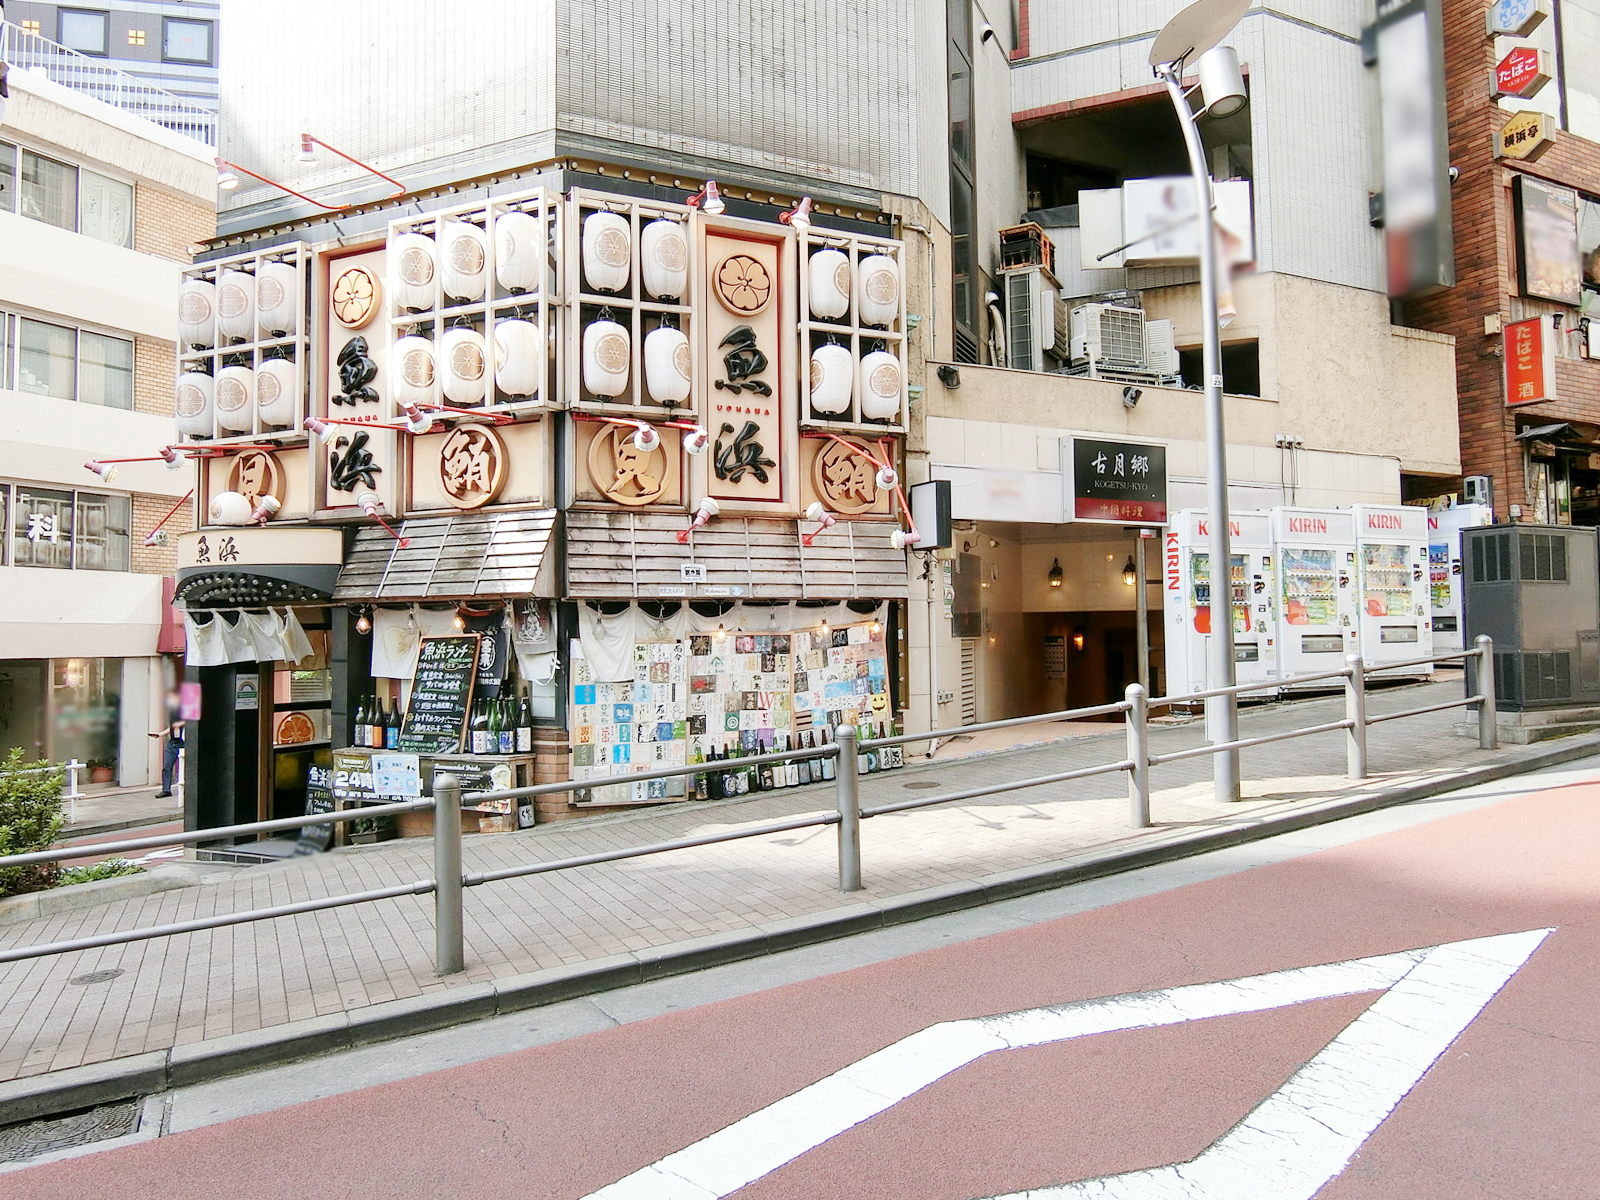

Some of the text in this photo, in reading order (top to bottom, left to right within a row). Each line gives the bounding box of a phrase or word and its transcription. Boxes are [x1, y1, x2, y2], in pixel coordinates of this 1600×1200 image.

[1500, 2, 1528, 21] KDY
[1503, 12, 1526, 28] ビル
[1499, 57, 1536, 84] たばこ
[1504, 125, 1538, 148] 横浜亭
[1515, 325, 1534, 399] たばこ 酒
[716, 404, 770, 416] UOHAMA
[1091, 450, 1149, 479] 古月郷
[1094, 479, 1148, 491] KOGETSU-KYO
[1100, 503, 1144, 518] 中国料理
[28, 513, 60, 545] 科
[1289, 517, 1327, 534] KIRIN
[1368, 514, 1402, 530] KIRIN
[1166, 532, 1180, 591] KIRIN
[421, 641, 468, 660] 魚浜ランチ
[333, 788, 346, 797] We
